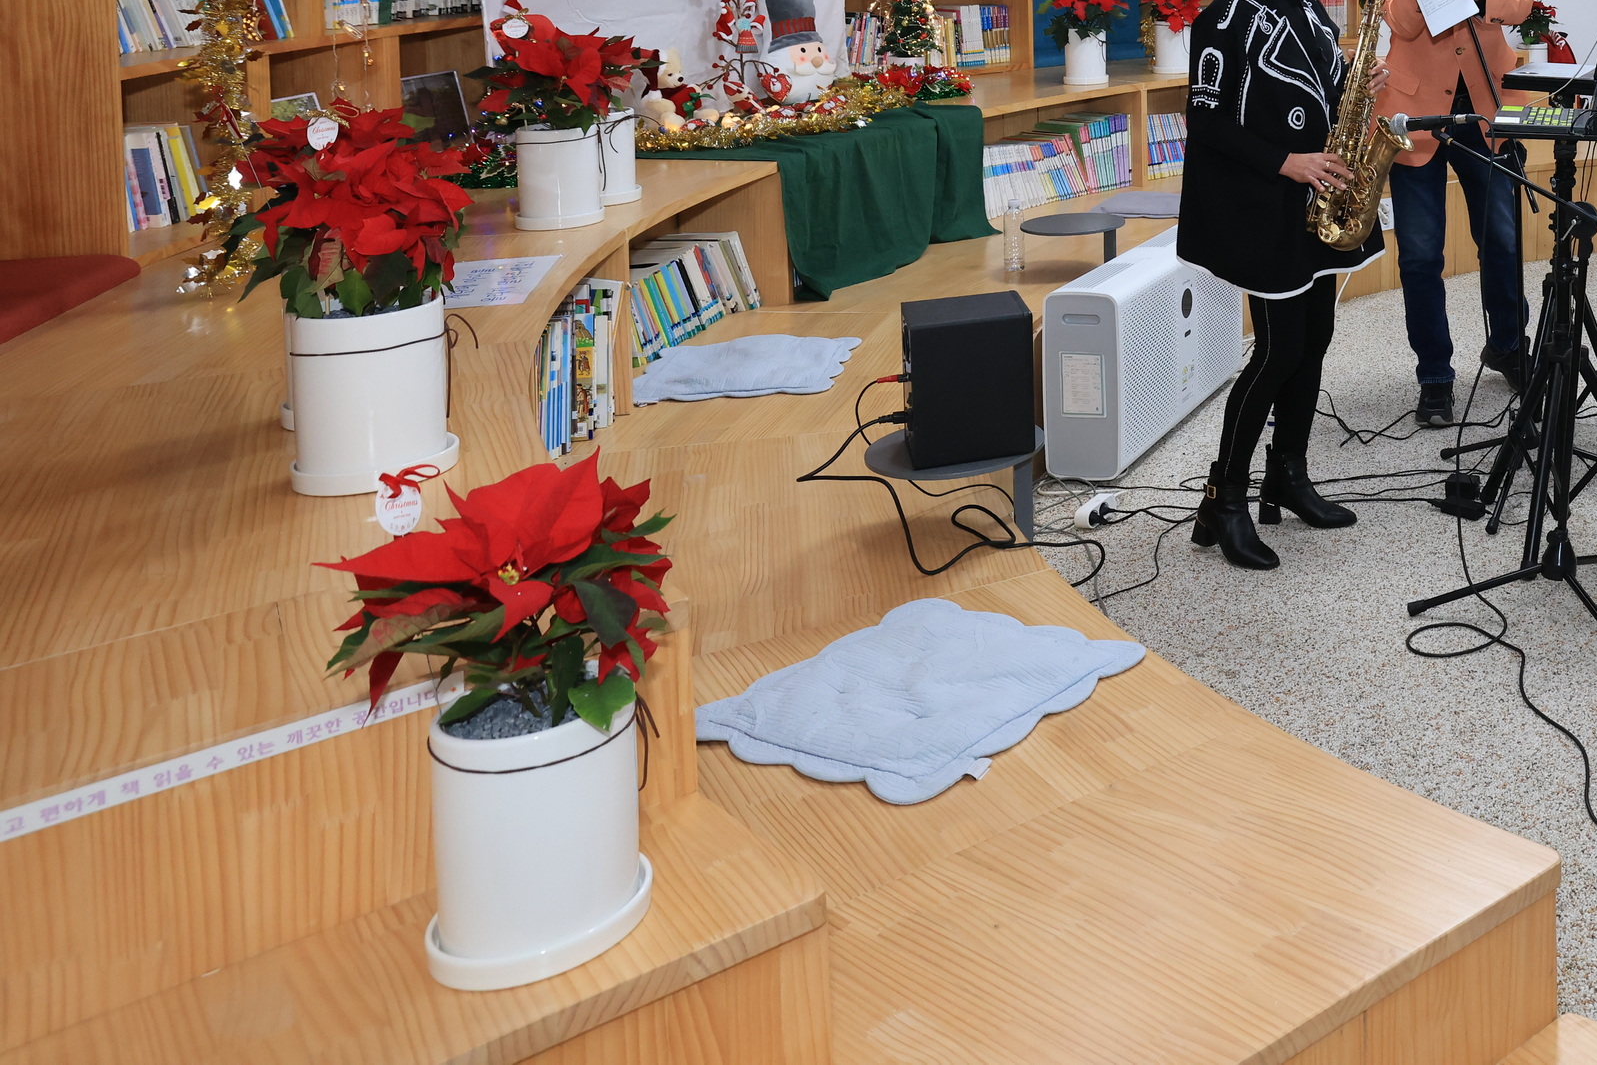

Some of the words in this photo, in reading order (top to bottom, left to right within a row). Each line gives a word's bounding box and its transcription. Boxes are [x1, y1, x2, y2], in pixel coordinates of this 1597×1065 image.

[385, 499, 418, 511] Christmas
[39, 789, 106, 823] 편하게
[120, 779, 140, 795] 책
[152, 763, 194, 788] 읽을
[206, 755, 225, 771] 수
[236, 741, 275, 762] 있는
[286, 717, 343, 745] 깨끗한
